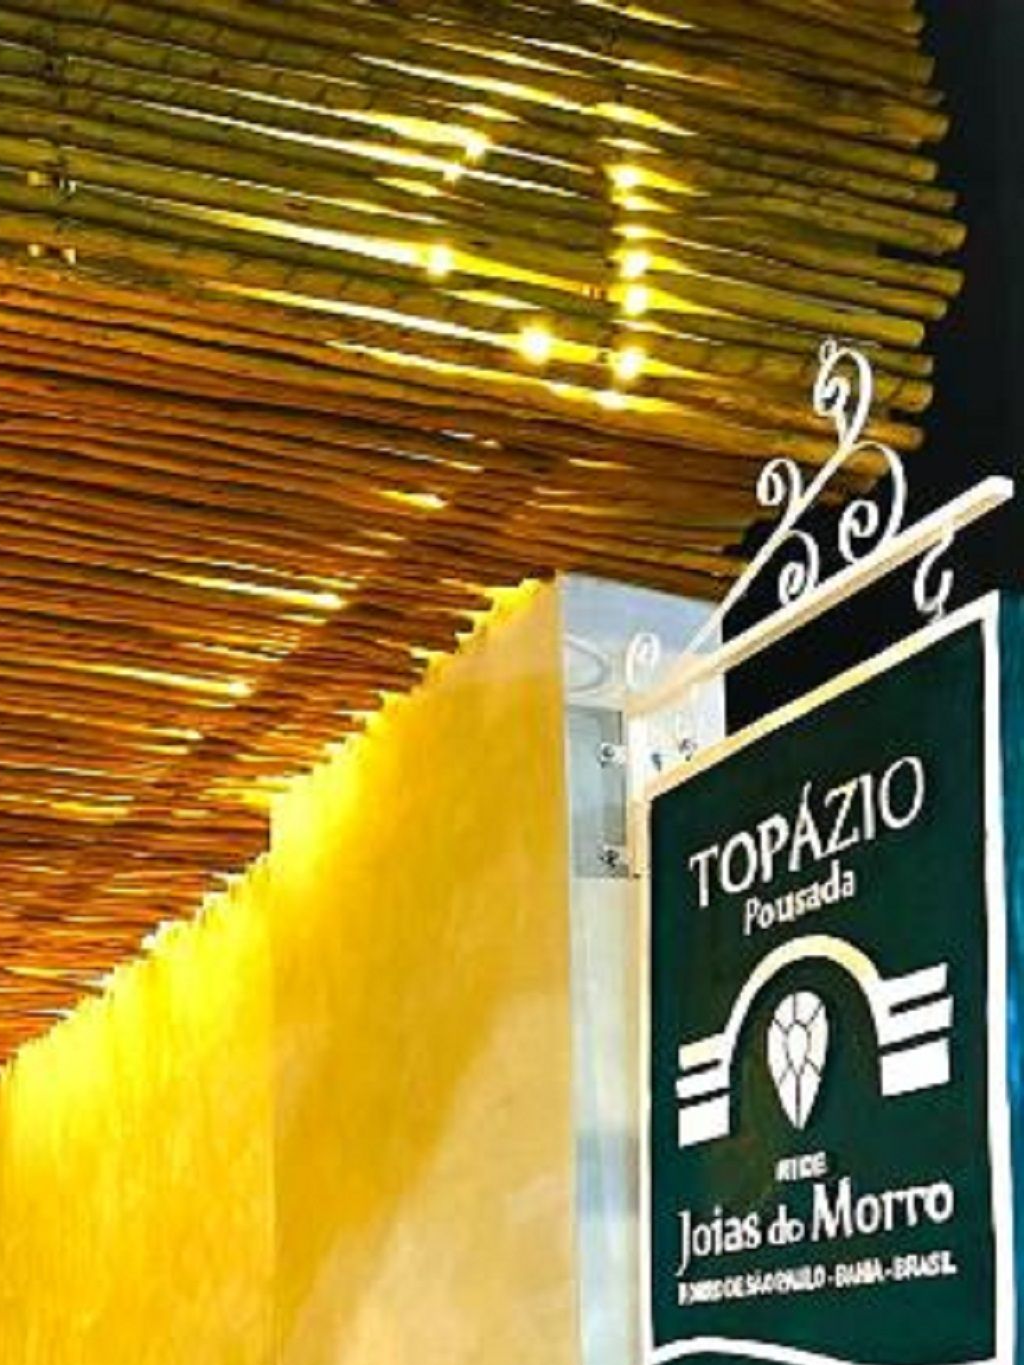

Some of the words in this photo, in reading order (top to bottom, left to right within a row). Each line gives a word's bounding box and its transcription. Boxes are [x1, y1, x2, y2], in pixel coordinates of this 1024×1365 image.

[688, 756, 925, 908] TOPÁZIO
[743, 859, 856, 936] Pousada
[676, 1206, 761, 1276] Joias
[767, 1204, 805, 1244] do
[811, 1176, 954, 1241] Morro
